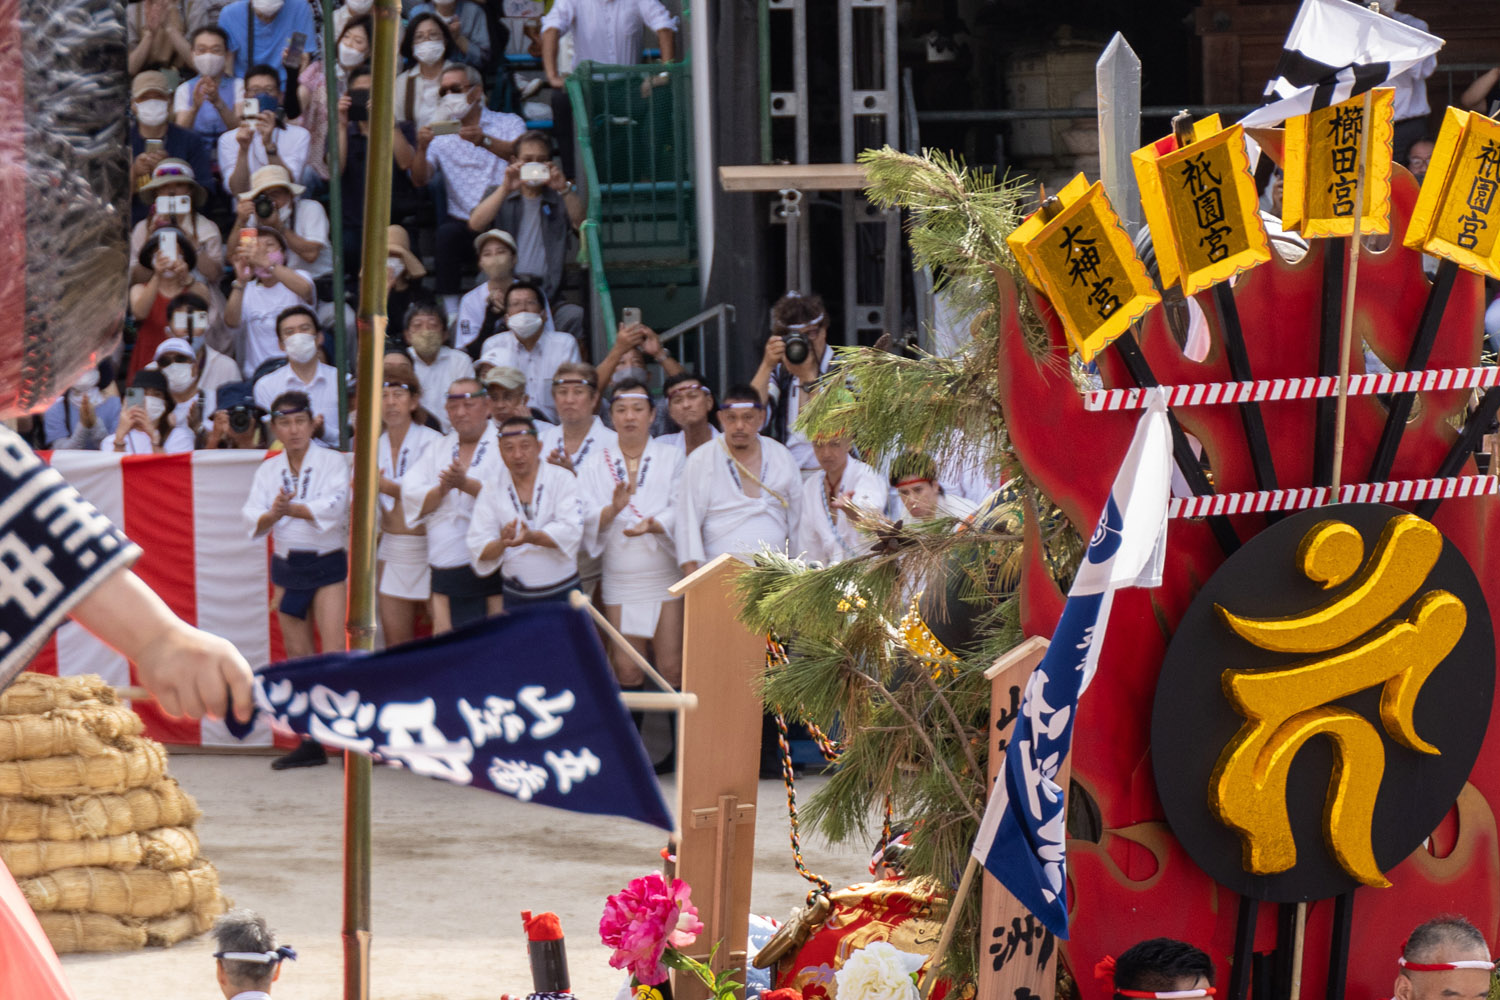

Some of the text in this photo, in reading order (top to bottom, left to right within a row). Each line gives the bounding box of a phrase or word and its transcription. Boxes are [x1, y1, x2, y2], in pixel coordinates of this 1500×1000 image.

[1326, 105, 1366, 219] 櫛田宮
[1058, 224, 1123, 320] 大神宮
